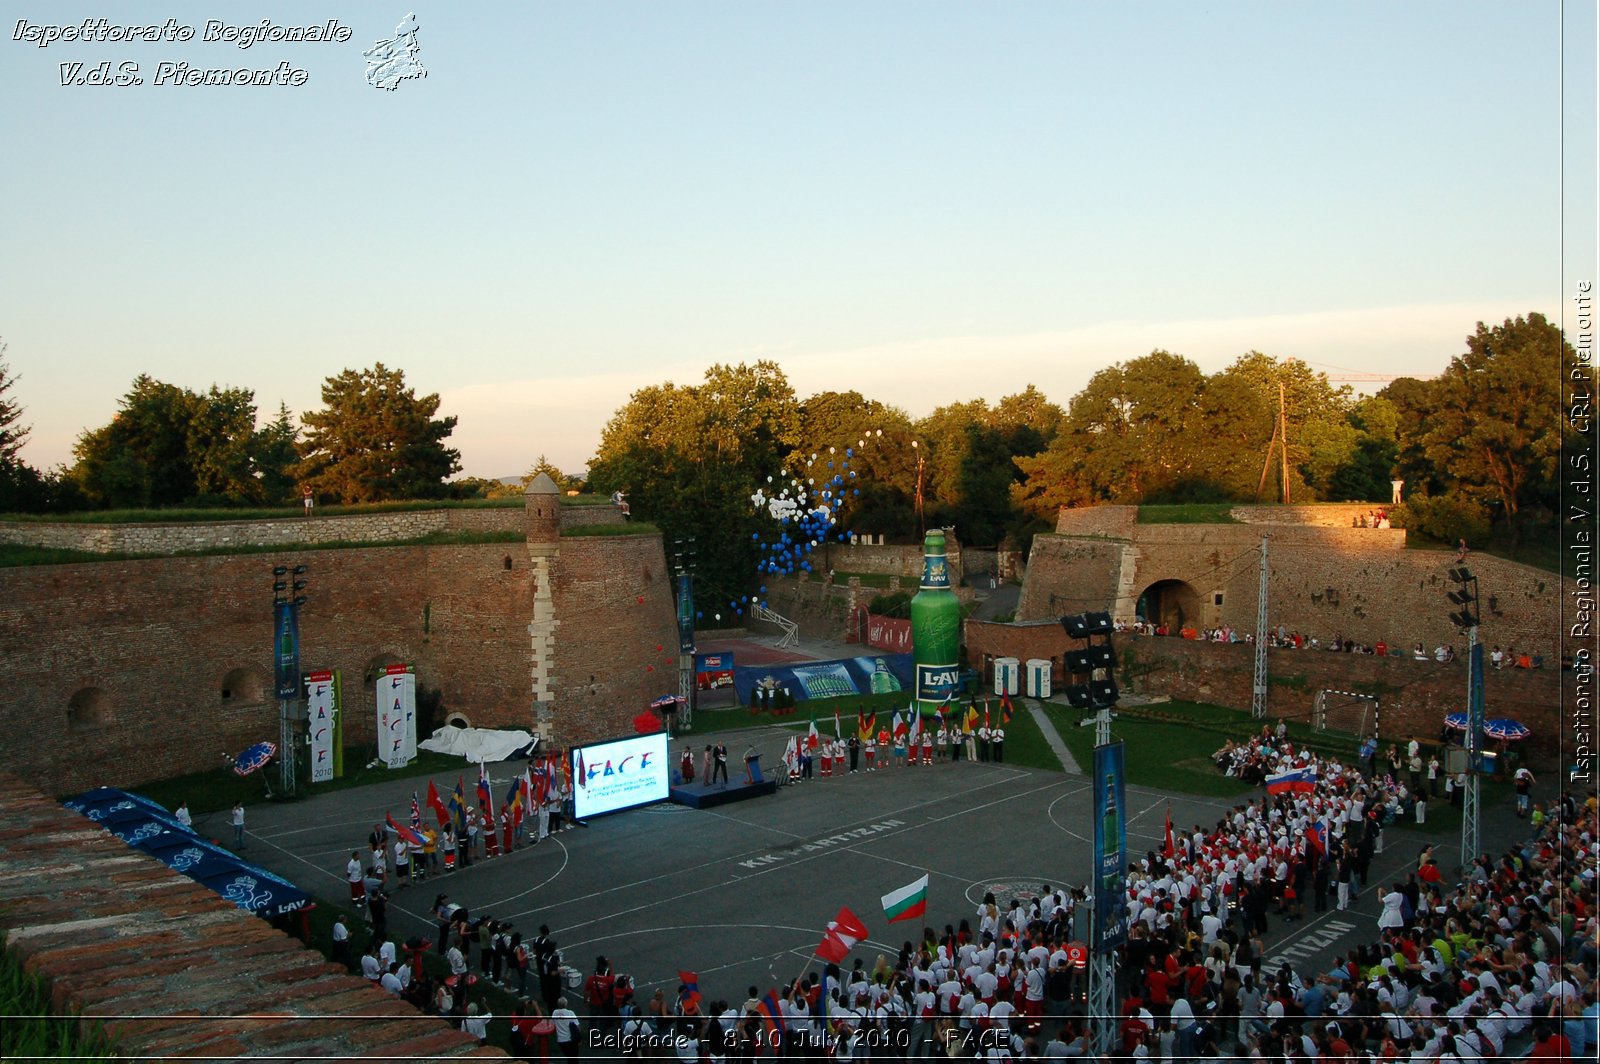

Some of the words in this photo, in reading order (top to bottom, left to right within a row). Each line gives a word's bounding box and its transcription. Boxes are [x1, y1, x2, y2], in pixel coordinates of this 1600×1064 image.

[924, 671, 959, 686] LAV
[389, 756, 407, 767] 2010
[314, 767, 333, 778] 2010
[278, 899, 306, 914] LAV
